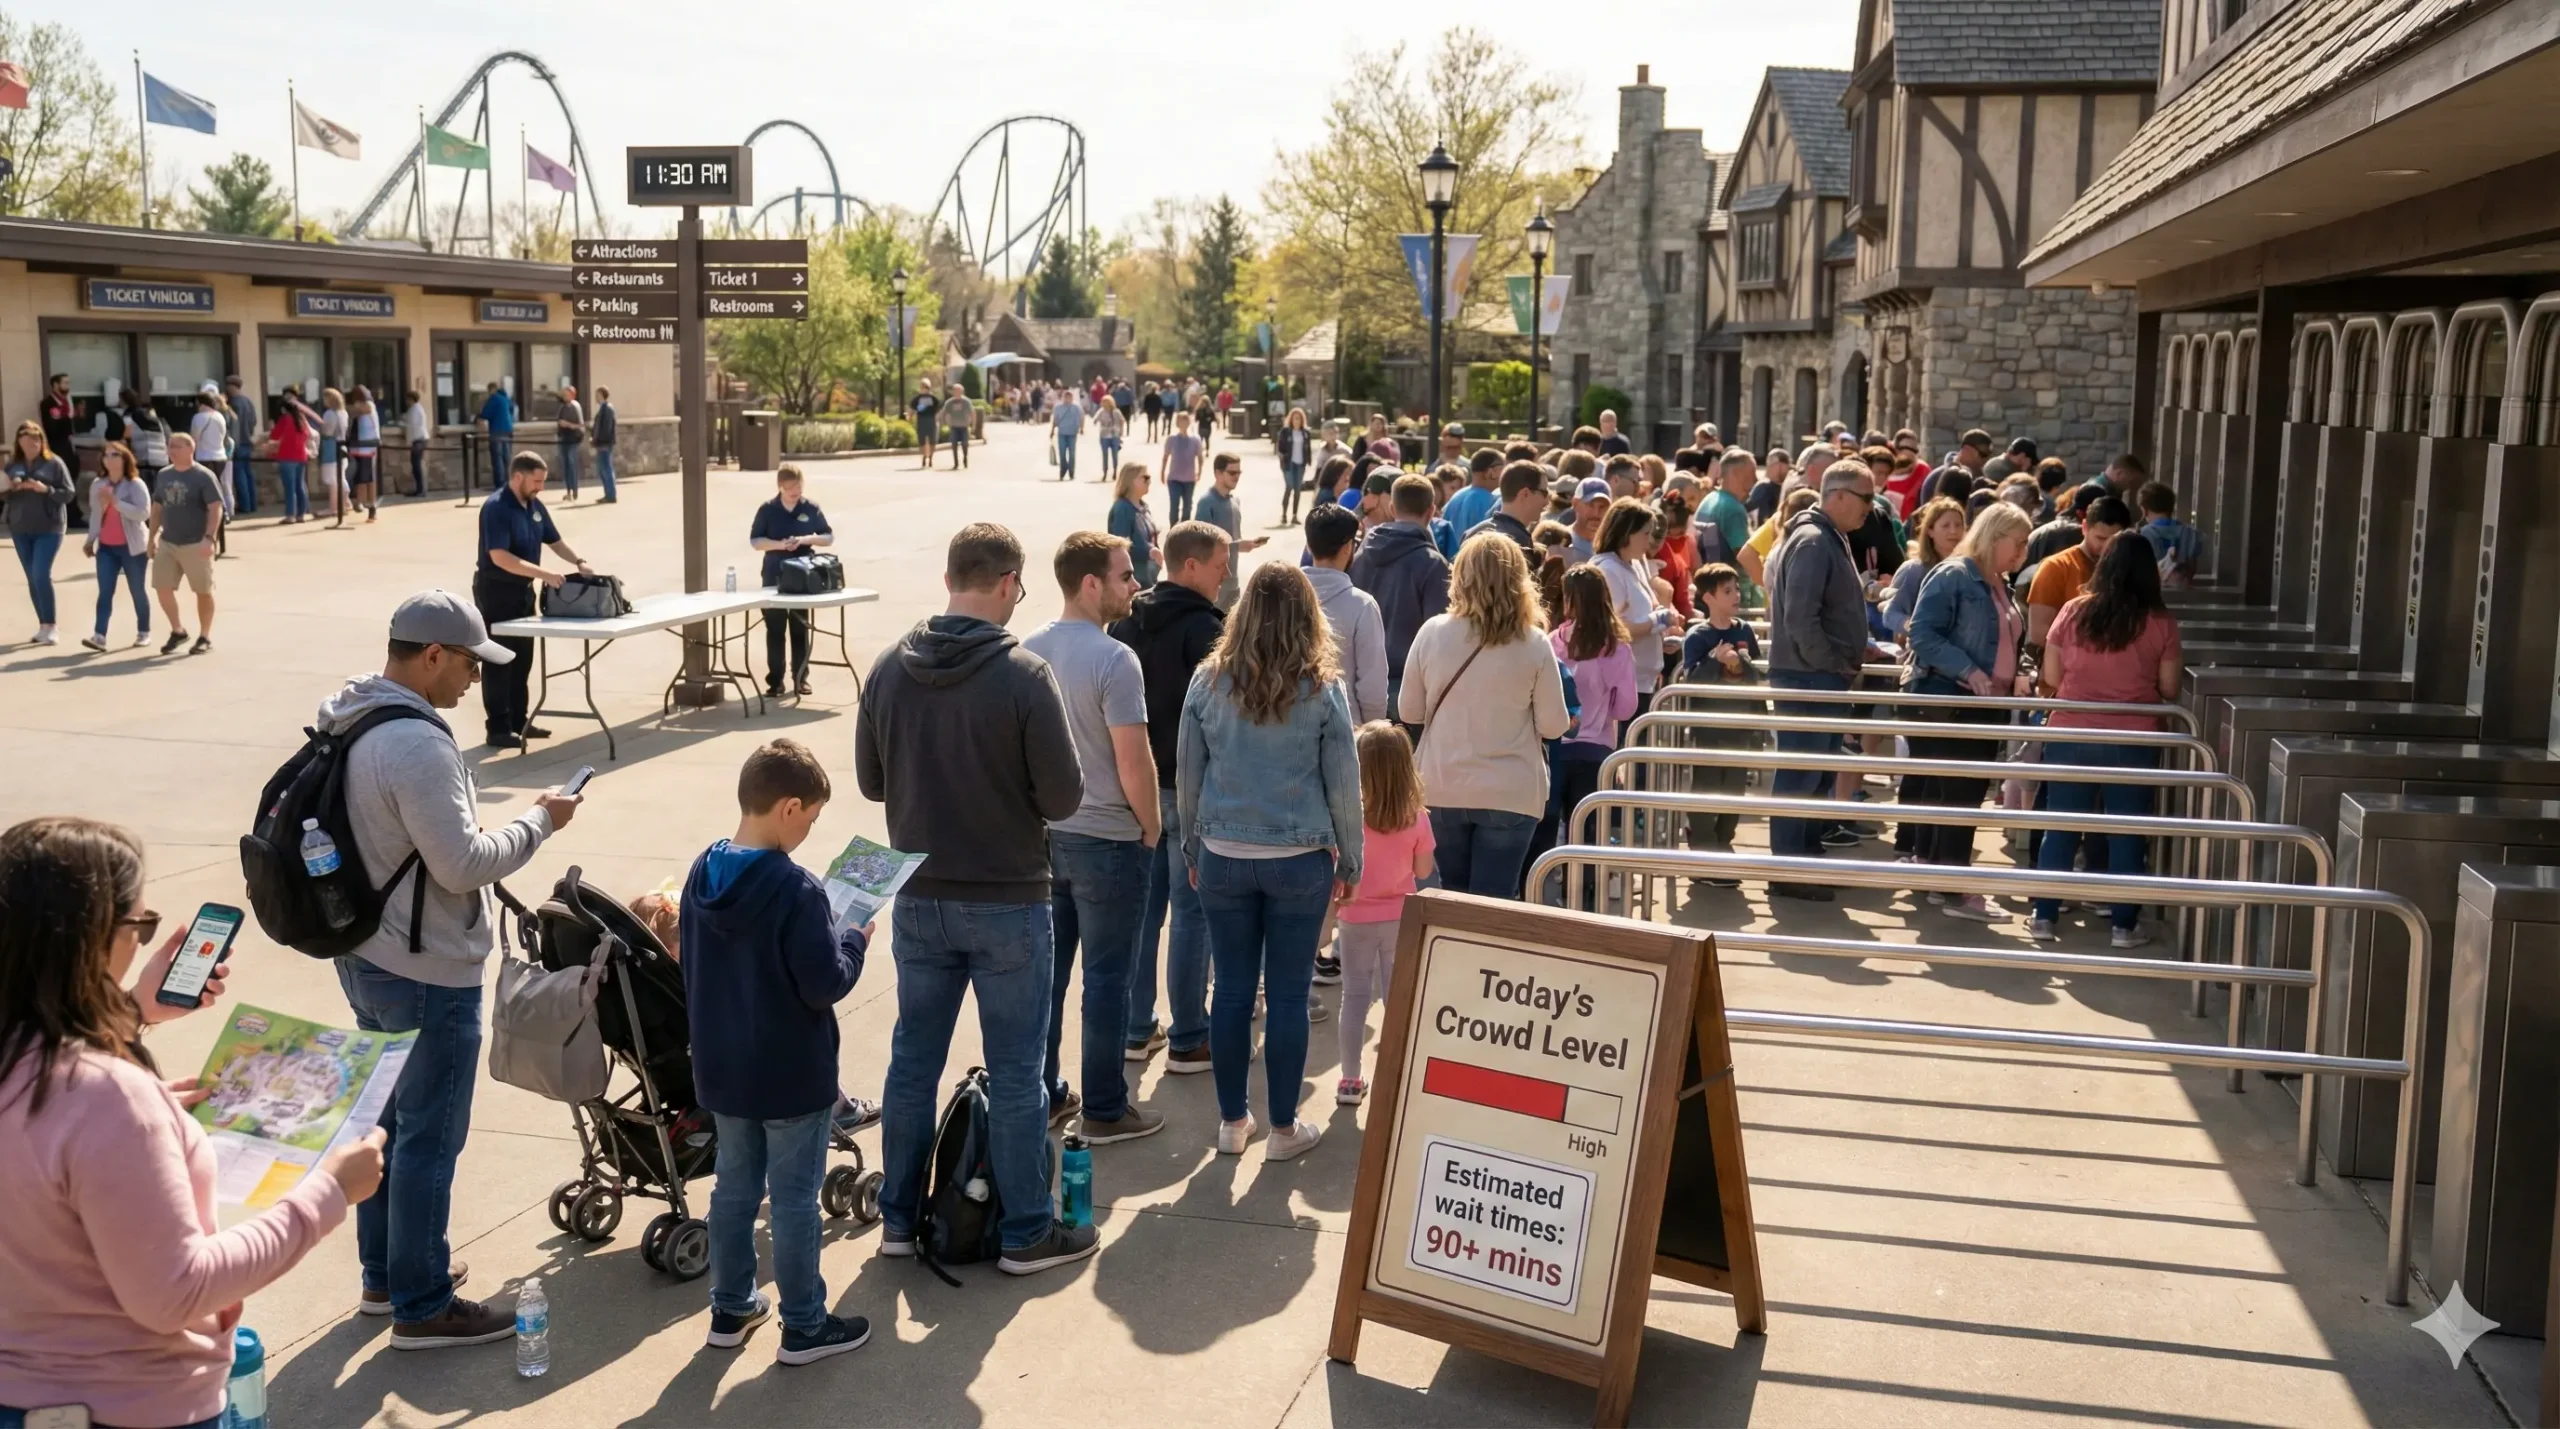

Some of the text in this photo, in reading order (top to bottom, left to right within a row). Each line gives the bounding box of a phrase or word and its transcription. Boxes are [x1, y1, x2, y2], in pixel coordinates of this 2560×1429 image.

[646, 163, 727, 185] 11:30 AM
[590, 243, 658, 259] Attractions
[592, 271, 664, 286] Restaurants
[709, 270, 757, 287] Ticket 1
[105, 288, 146, 303] TICKET
[592, 297, 638, 315] Parking
[709, 298, 775, 314] Restrooms
[593, 323, 656, 340] Restrooms
[1480, 968, 1595, 1021] Today’s
[1435, 1004, 1629, 1071] Crowd Level
[1567, 1132, 1608, 1160] High
[1444, 1158, 1565, 1210] Estimated
[1435, 1193, 1566, 1244] wait times:
[1426, 1224, 1563, 1288] 90+ mins
